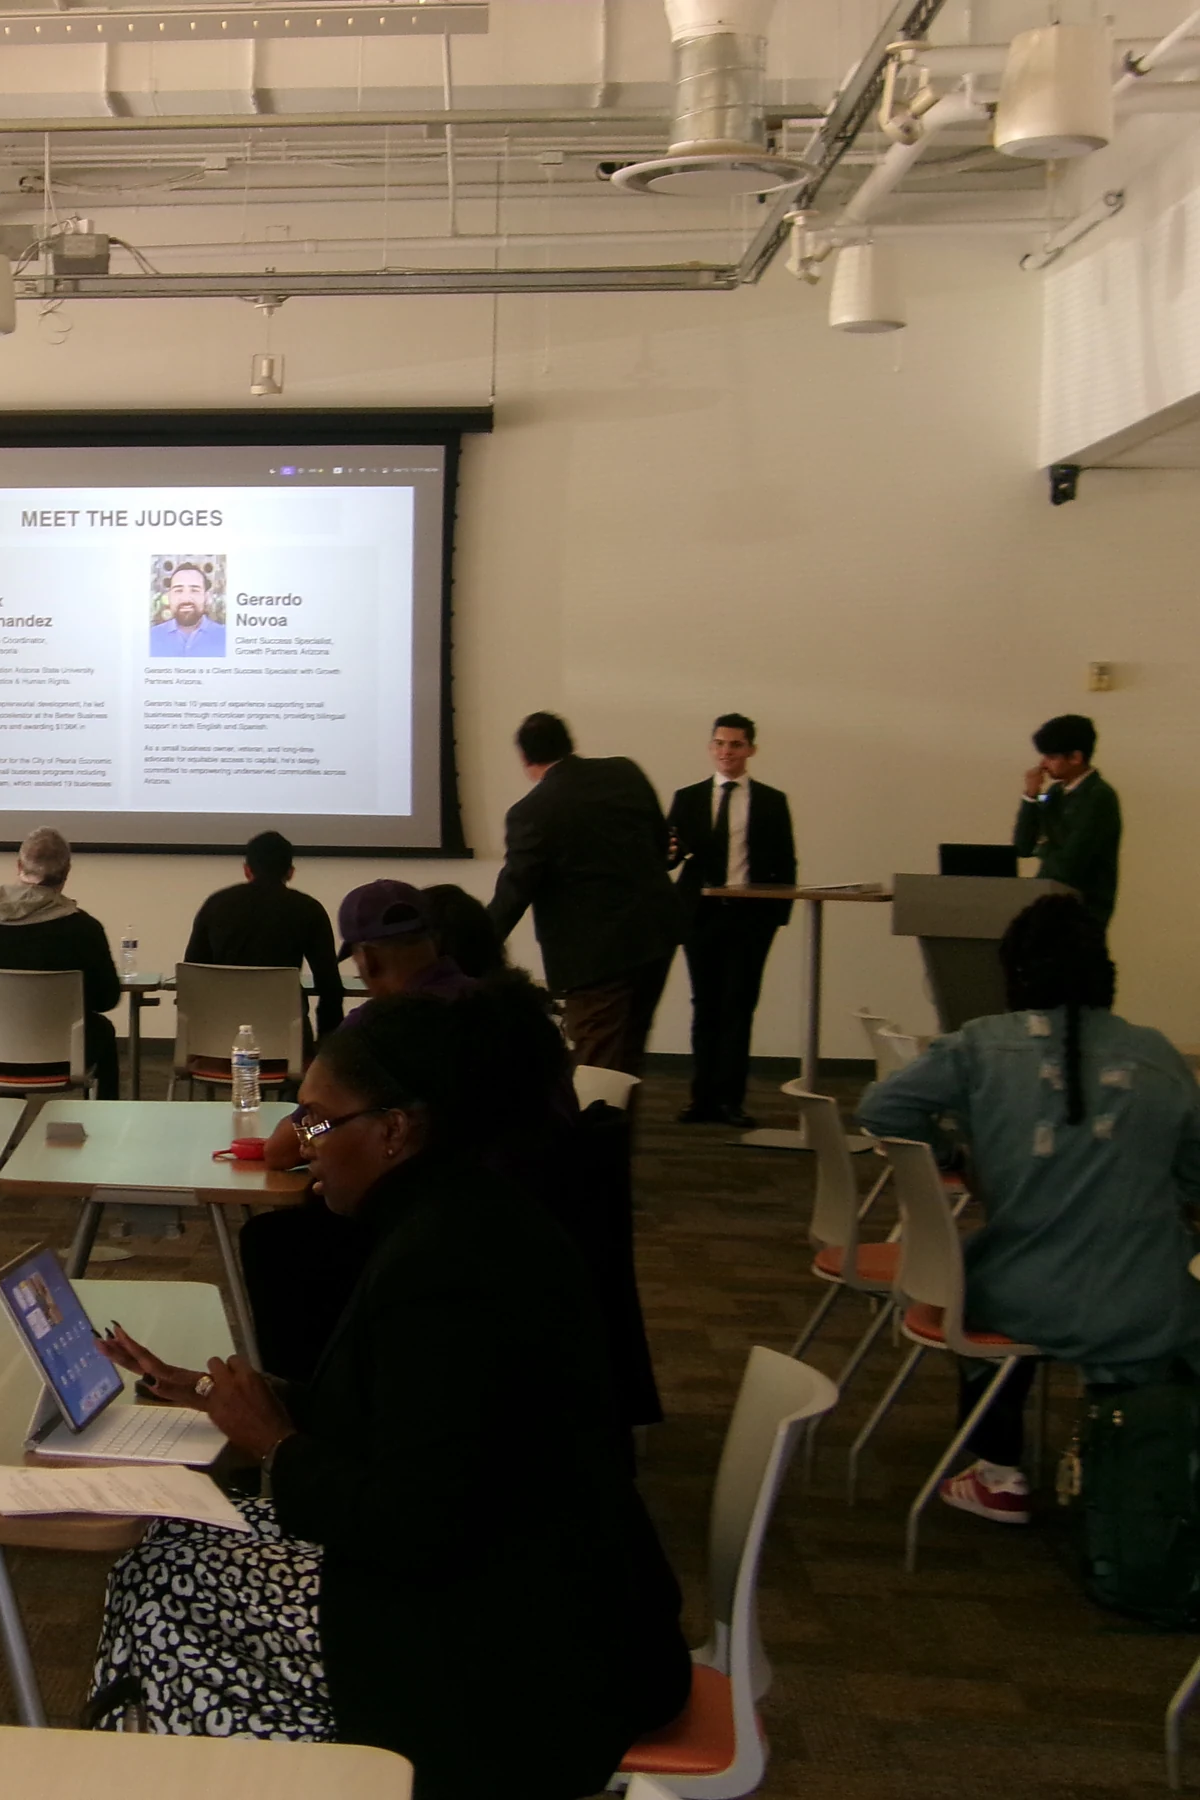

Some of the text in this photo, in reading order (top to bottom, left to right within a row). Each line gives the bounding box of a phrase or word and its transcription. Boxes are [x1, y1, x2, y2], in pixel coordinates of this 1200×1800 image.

[21, 509, 223, 527] MEET THE JUDGES
[236, 592, 303, 606] Gerardo
[236, 613, 288, 627] Novoa
[235, 637, 258, 645] Client
[259, 637, 292, 645] Success
